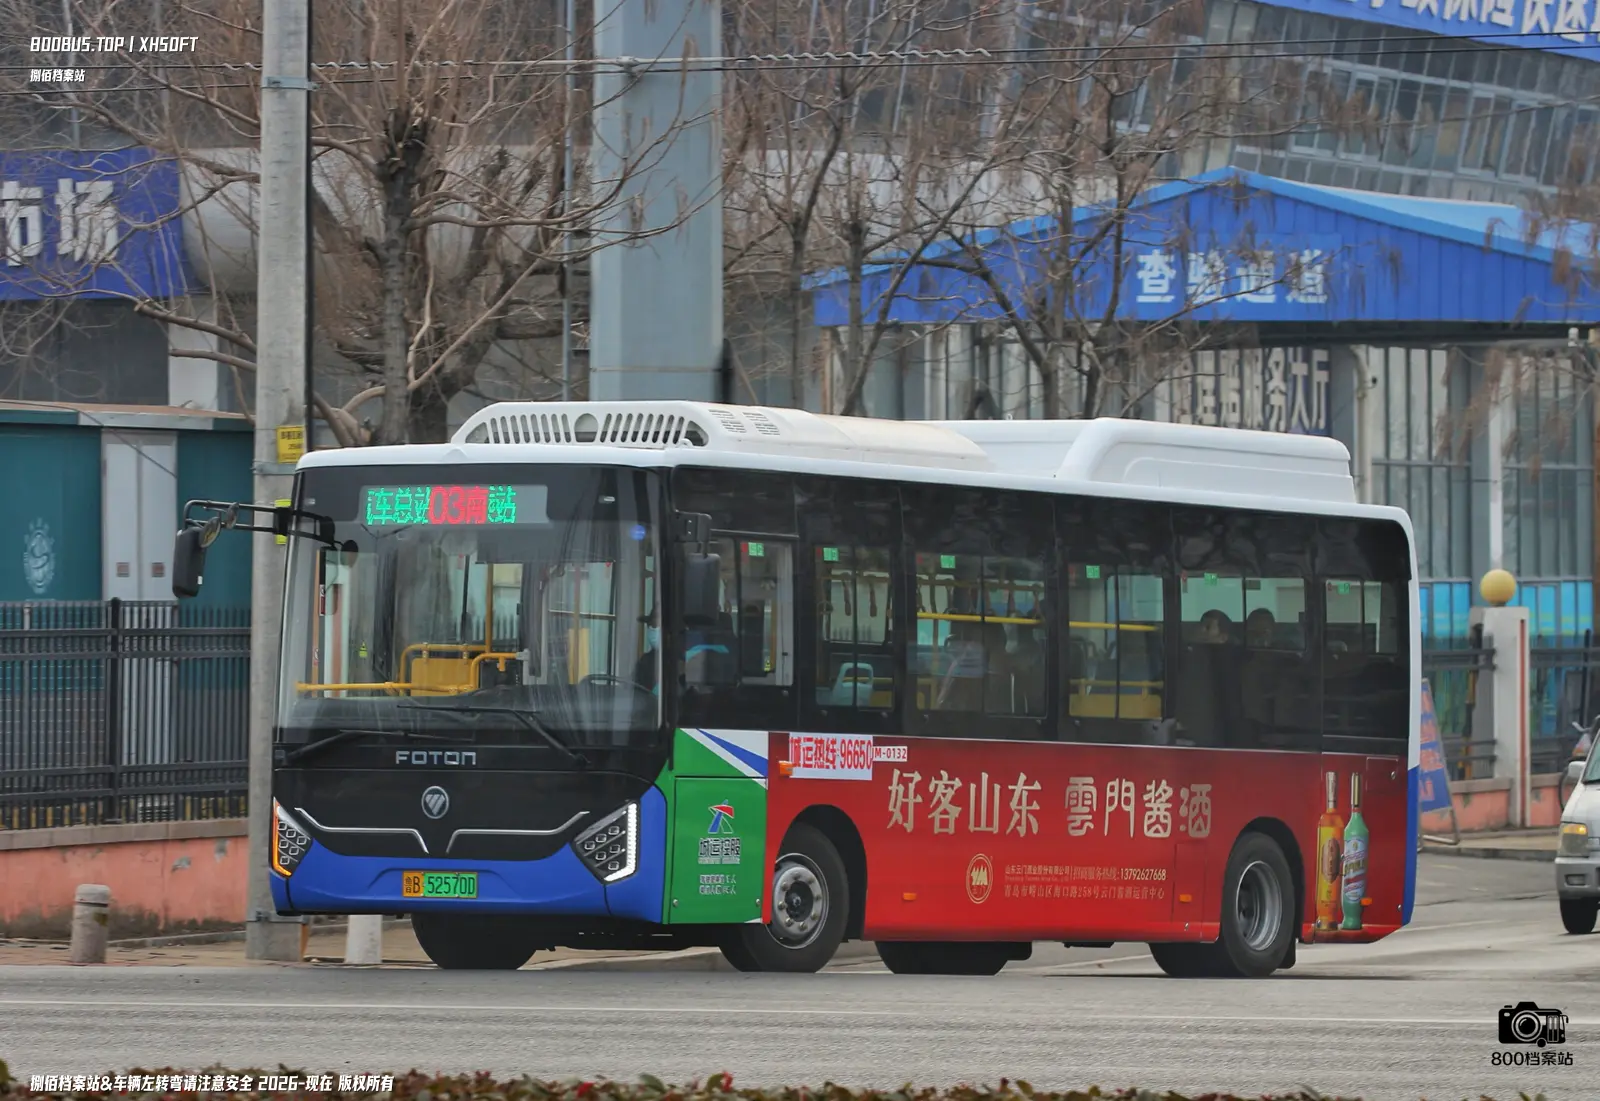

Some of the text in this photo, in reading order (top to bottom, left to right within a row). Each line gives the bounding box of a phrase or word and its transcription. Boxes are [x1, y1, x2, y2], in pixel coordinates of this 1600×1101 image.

[1135, 249, 1328, 304] 查验通道
[395, 750, 477, 766] FOTON
[887, 768, 1042, 838] 好客山东
[699, 837, 741, 857] 城运控股
